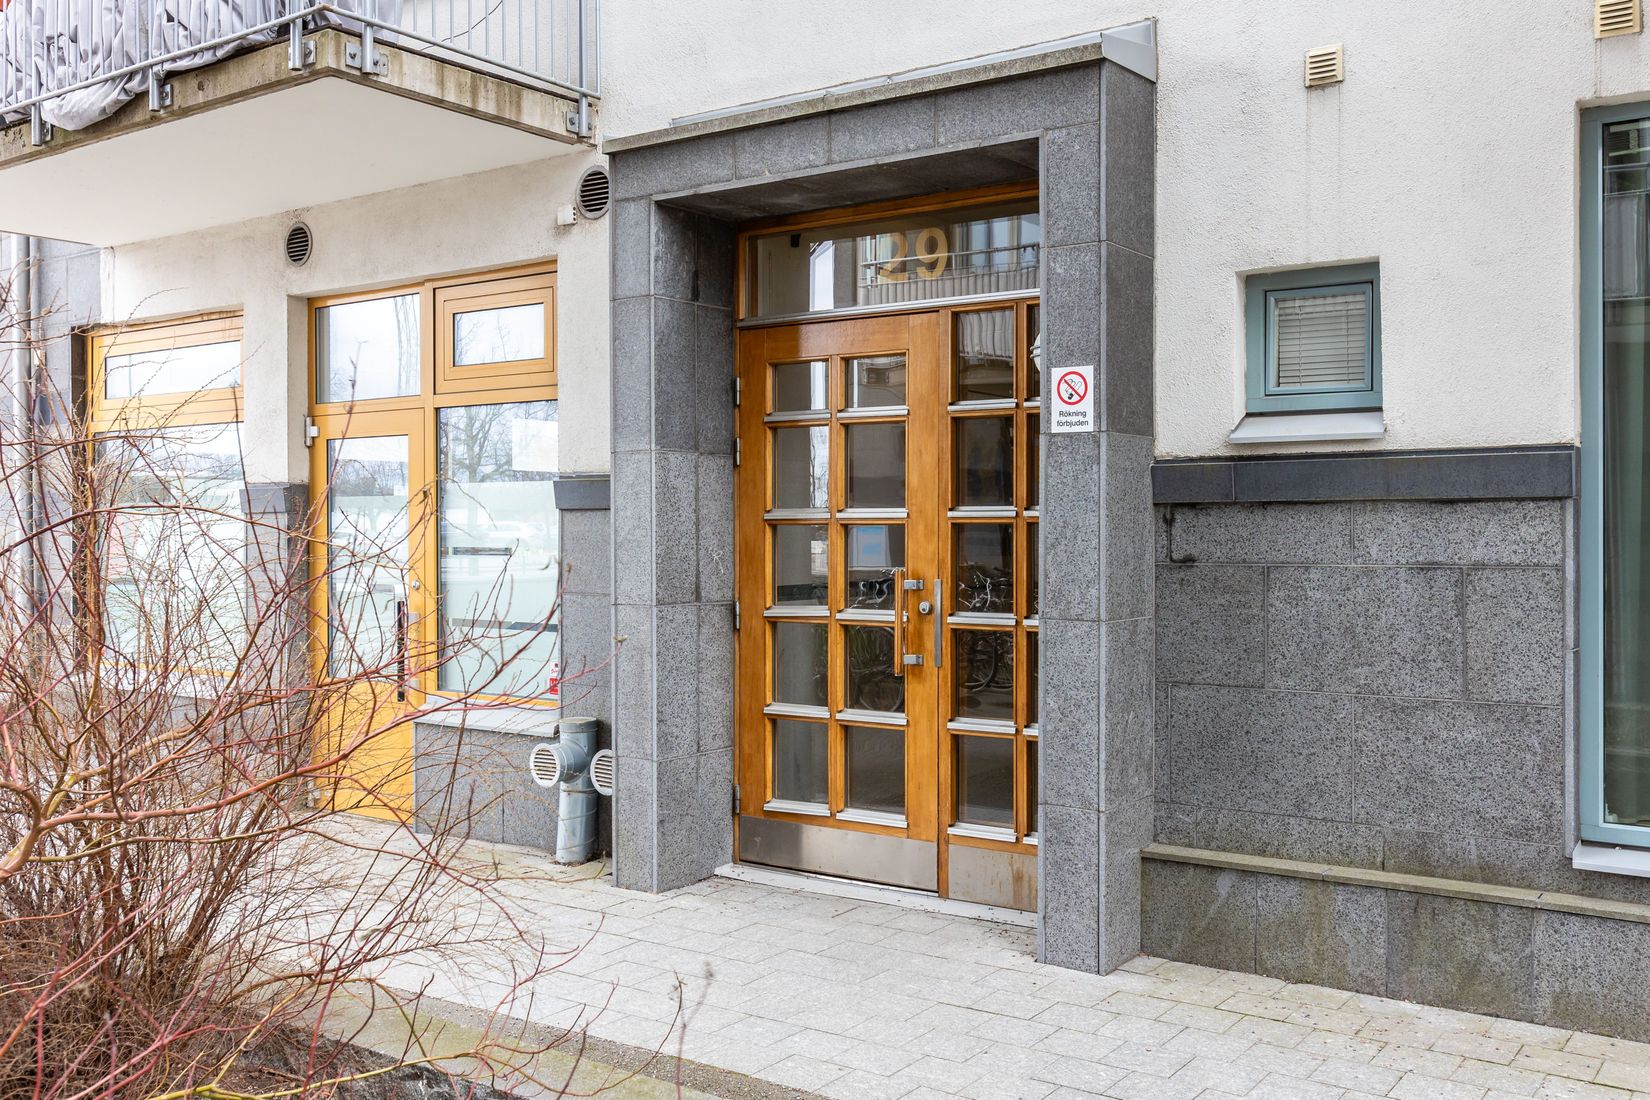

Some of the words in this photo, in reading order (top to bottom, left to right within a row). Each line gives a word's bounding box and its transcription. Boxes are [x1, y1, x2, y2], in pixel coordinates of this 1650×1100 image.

[878, 227, 948, 283] 29
[1058, 410, 1087, 419] Rökning
[1056, 419, 1089, 428] förbjuden
